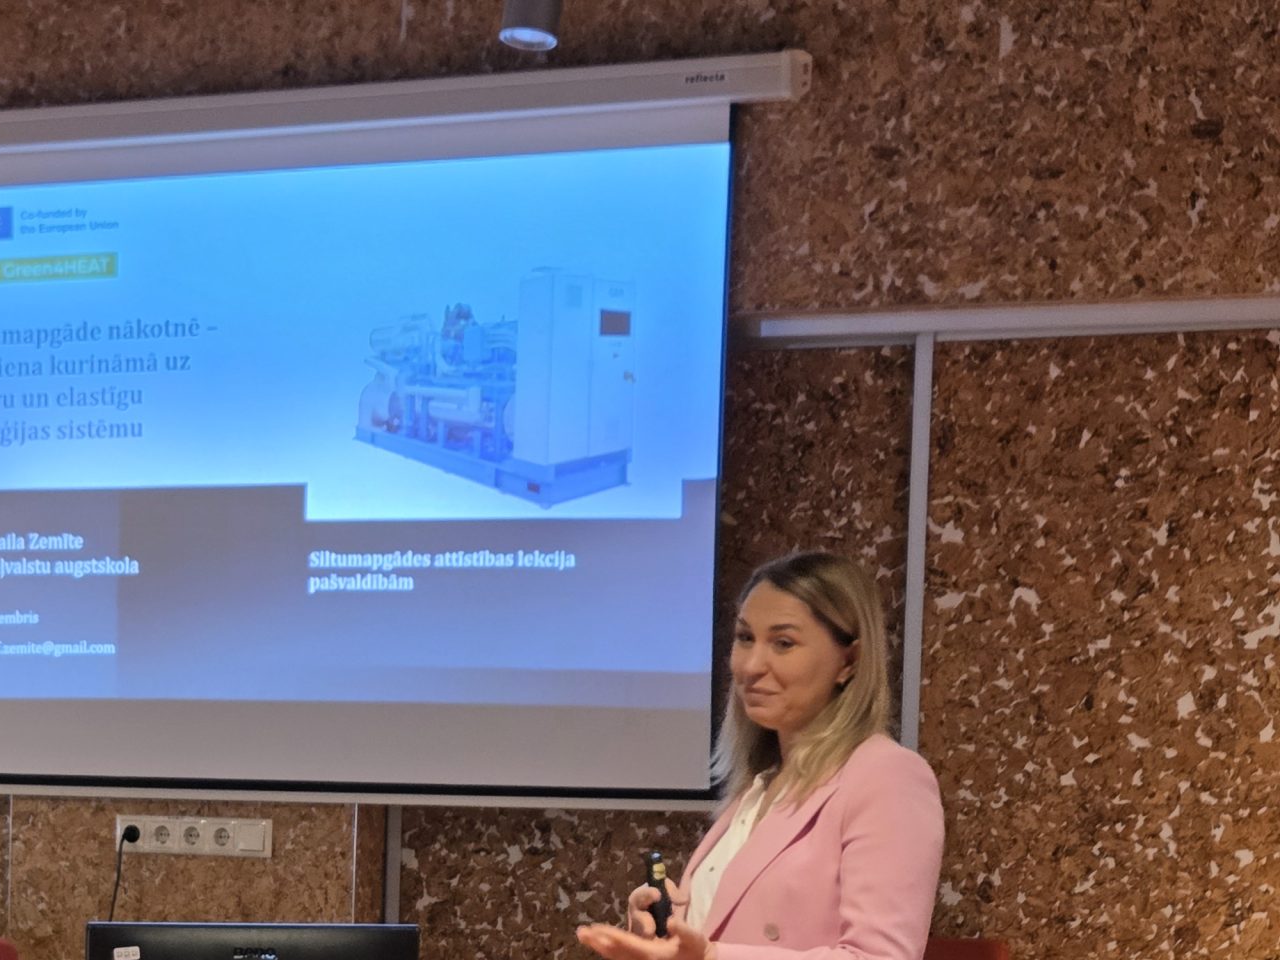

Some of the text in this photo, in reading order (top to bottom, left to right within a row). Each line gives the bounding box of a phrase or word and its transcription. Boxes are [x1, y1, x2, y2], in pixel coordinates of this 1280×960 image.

[75, 207, 87, 219] by
[39, 221, 86, 234] European
[90, 220, 119, 231] Union
[107, 318, 200, 341] nākotnē
[50, 353, 158, 376] kurināmā
[165, 354, 191, 371] uz
[22, 392, 49, 409] un
[56, 386, 143, 410] elastīgu
[56, 420, 143, 442] sistēmu
[54, 556, 139, 578] augstskola
[309, 550, 431, 570] Siltumapgādes
[518, 550, 576, 570] lekcija
